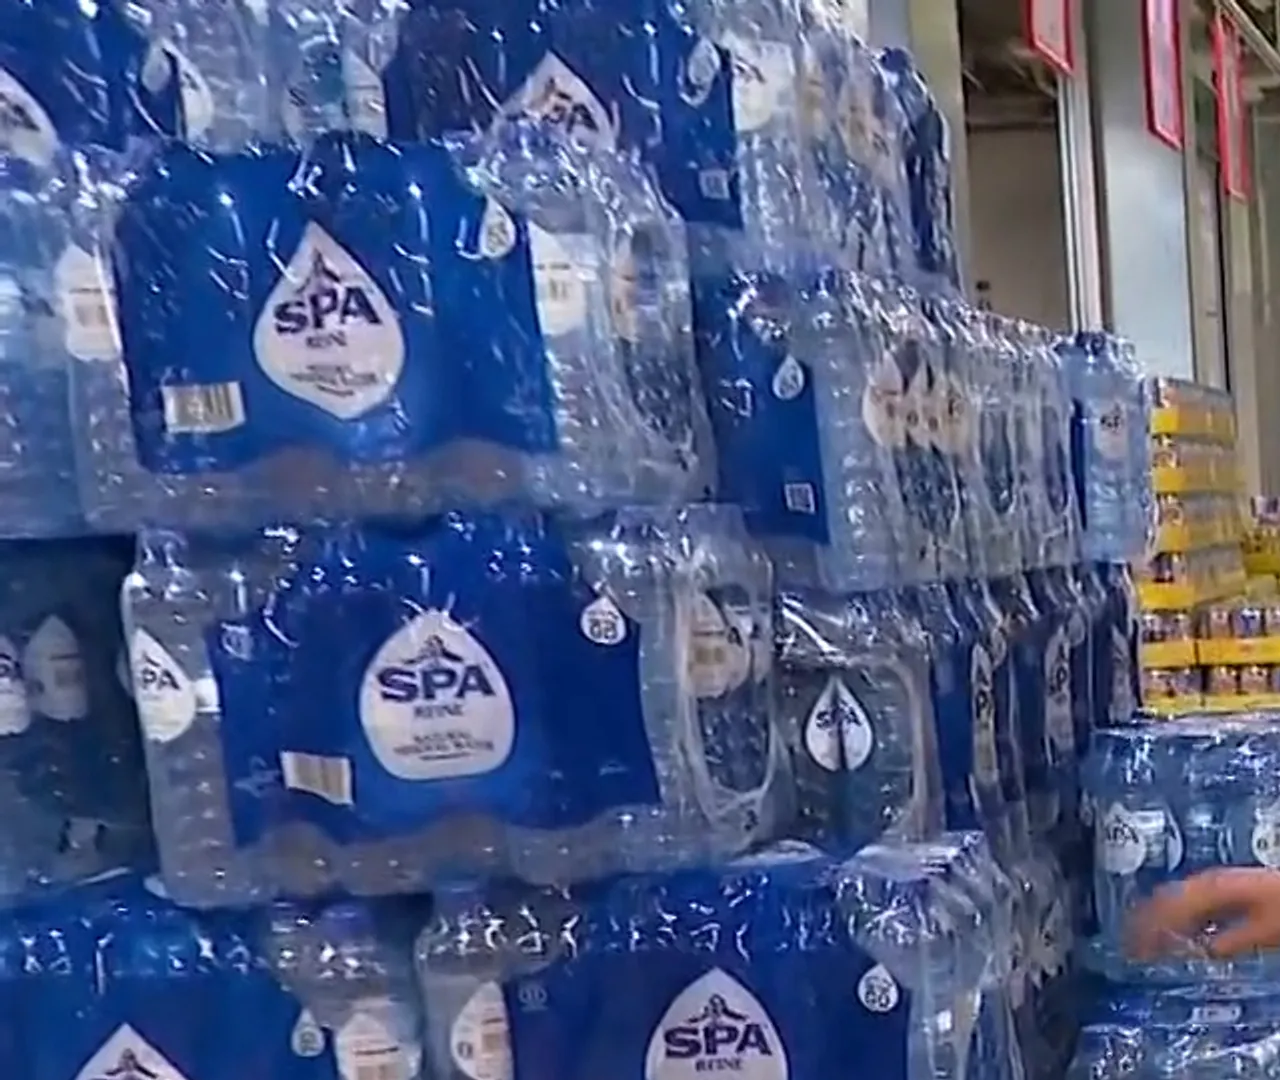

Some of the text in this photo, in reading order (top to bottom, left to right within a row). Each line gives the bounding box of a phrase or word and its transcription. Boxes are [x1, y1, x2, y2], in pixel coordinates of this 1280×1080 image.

[274, 287, 382, 334] SPA
[142, 666, 182, 690] PA
[377, 664, 496, 703] SPA
[413, 703, 464, 718] REINE
[664, 1023, 774, 1060] SPA
[694, 1059, 745, 1073] REINE
